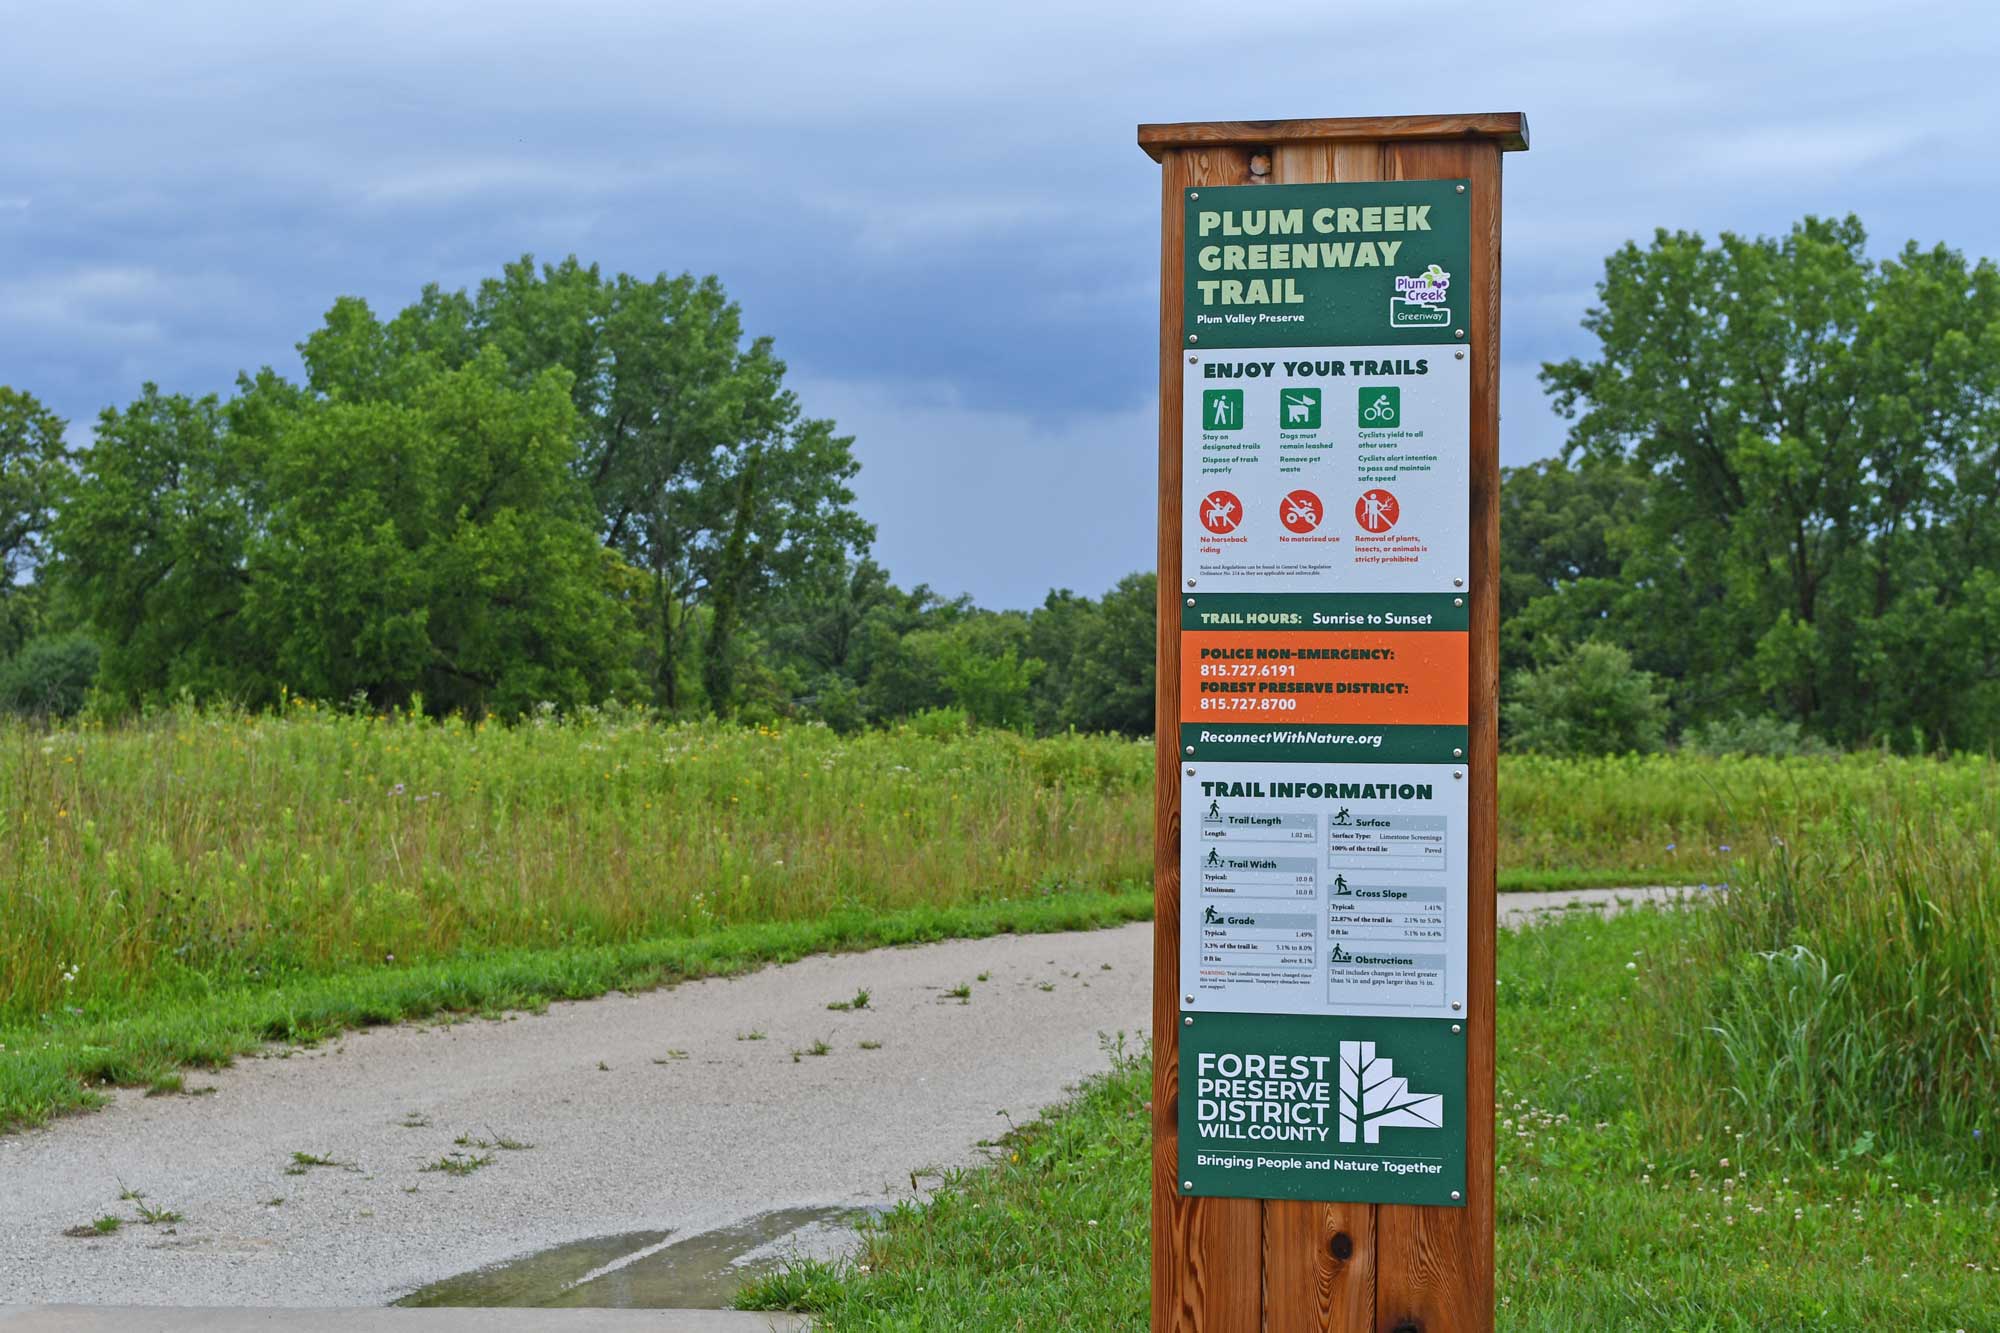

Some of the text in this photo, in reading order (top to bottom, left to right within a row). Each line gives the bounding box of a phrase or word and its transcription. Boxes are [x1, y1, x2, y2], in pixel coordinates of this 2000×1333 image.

[1199, 206, 1432, 236] PLUM CREEK
[1198, 241, 1402, 271] GREENWAY
[1398, 278, 1426, 289] Plum
[1198, 278, 1304, 305] TRAIL
[1408, 290, 1443, 300] Creek
[1197, 314, 1304, 325] Plum Valley Preserve
[1397, 313, 1443, 321] Greenway
[1204, 359, 1428, 378] ENJOY YOUR TRAILS
[1202, 433, 1218, 441] Stay
[1280, 432, 1297, 440] Dogs
[1358, 431, 1385, 439] Cyclists
[1387, 431, 1404, 439] yield
[1202, 443, 1241, 451] designated
[1202, 456, 1230, 464] Dispose
[1308, 456, 1321, 464] pet
[1358, 455, 1385, 463] Cyclists
[1202, 466, 1232, 474] properly
[1375, 475, 1396, 483] speed
[1396, 535, 1420, 543] plants,
[1200, 546, 1220, 555] riding
[1355, 555, 1419, 564] strictly prohibited
[1201, 612, 1432, 625] TRAIL HOURS: Sunrise to Sunset
[1200, 648, 1395, 660] POLICE NON-EMERGENCY:
[1200, 665, 1295, 676] 815.727.6191
[1200, 682, 1409, 694] FOREST PRESERVE DISTRICT:
[1200, 699, 1296, 710] 815.727.8700
[1200, 731, 1382, 746] ReconnectWithNature.org
[1201, 782, 1432, 799] TRAIL INFORMATION
[1228, 816, 1282, 826] Trail Length
[1356, 819, 1390, 827] Surface
[1228, 860, 1248, 868] Trail
[1382, 890, 1408, 900] Slope
[1228, 917, 1255, 925] Grade
[1355, 956, 1413, 965] Obstructions
[1198, 1053, 1330, 1080] FOREST
[1198, 1079, 1330, 1101] PRESERVE
[1197, 1099, 1330, 1124] DISTRICT
[1198, 1123, 1329, 1142] WILL COUNTY
[1197, 1155, 1442, 1175] Bringing People and Nature Together
